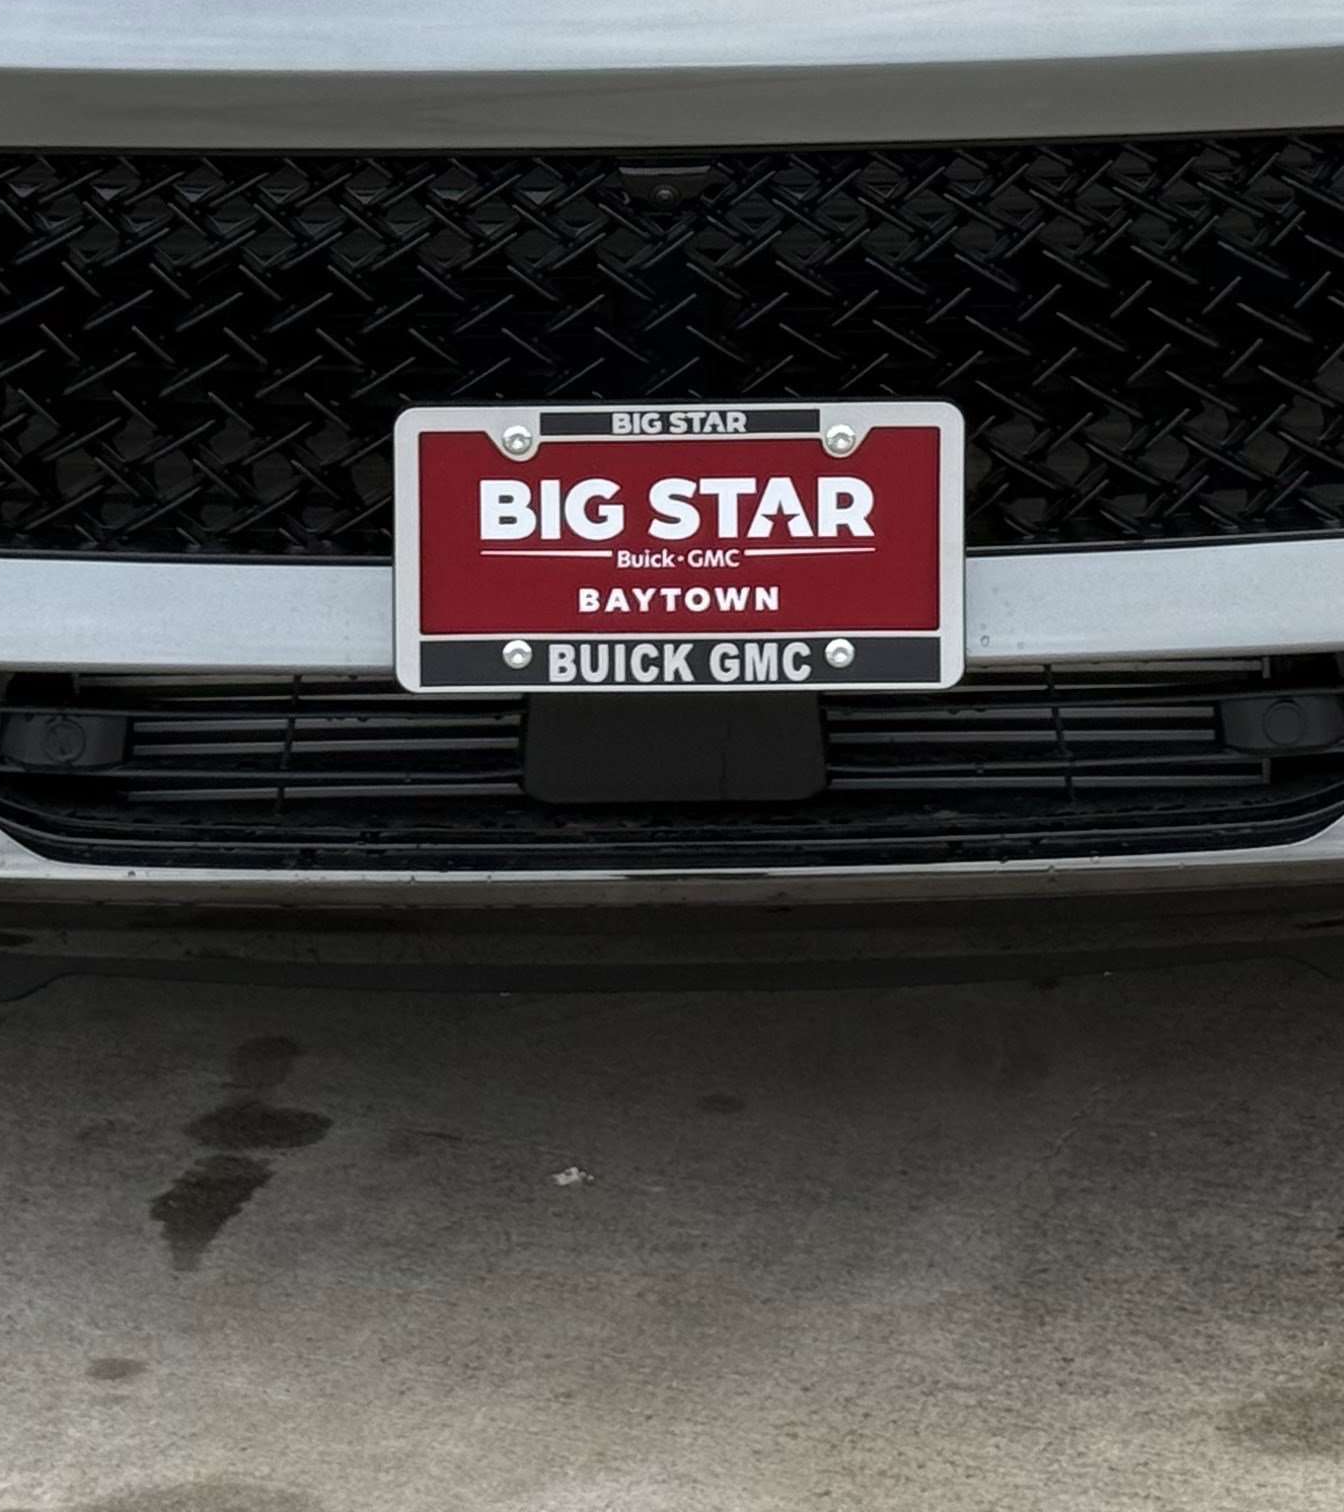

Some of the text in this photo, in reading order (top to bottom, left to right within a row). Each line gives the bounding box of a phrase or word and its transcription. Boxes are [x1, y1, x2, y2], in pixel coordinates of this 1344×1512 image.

[612, 411, 748, 434] BIG STAR
[480, 477, 875, 540] BIG STAR
[578, 586, 779, 612] BAYTOWN
[548, 641, 812, 682] BUICK GMC
